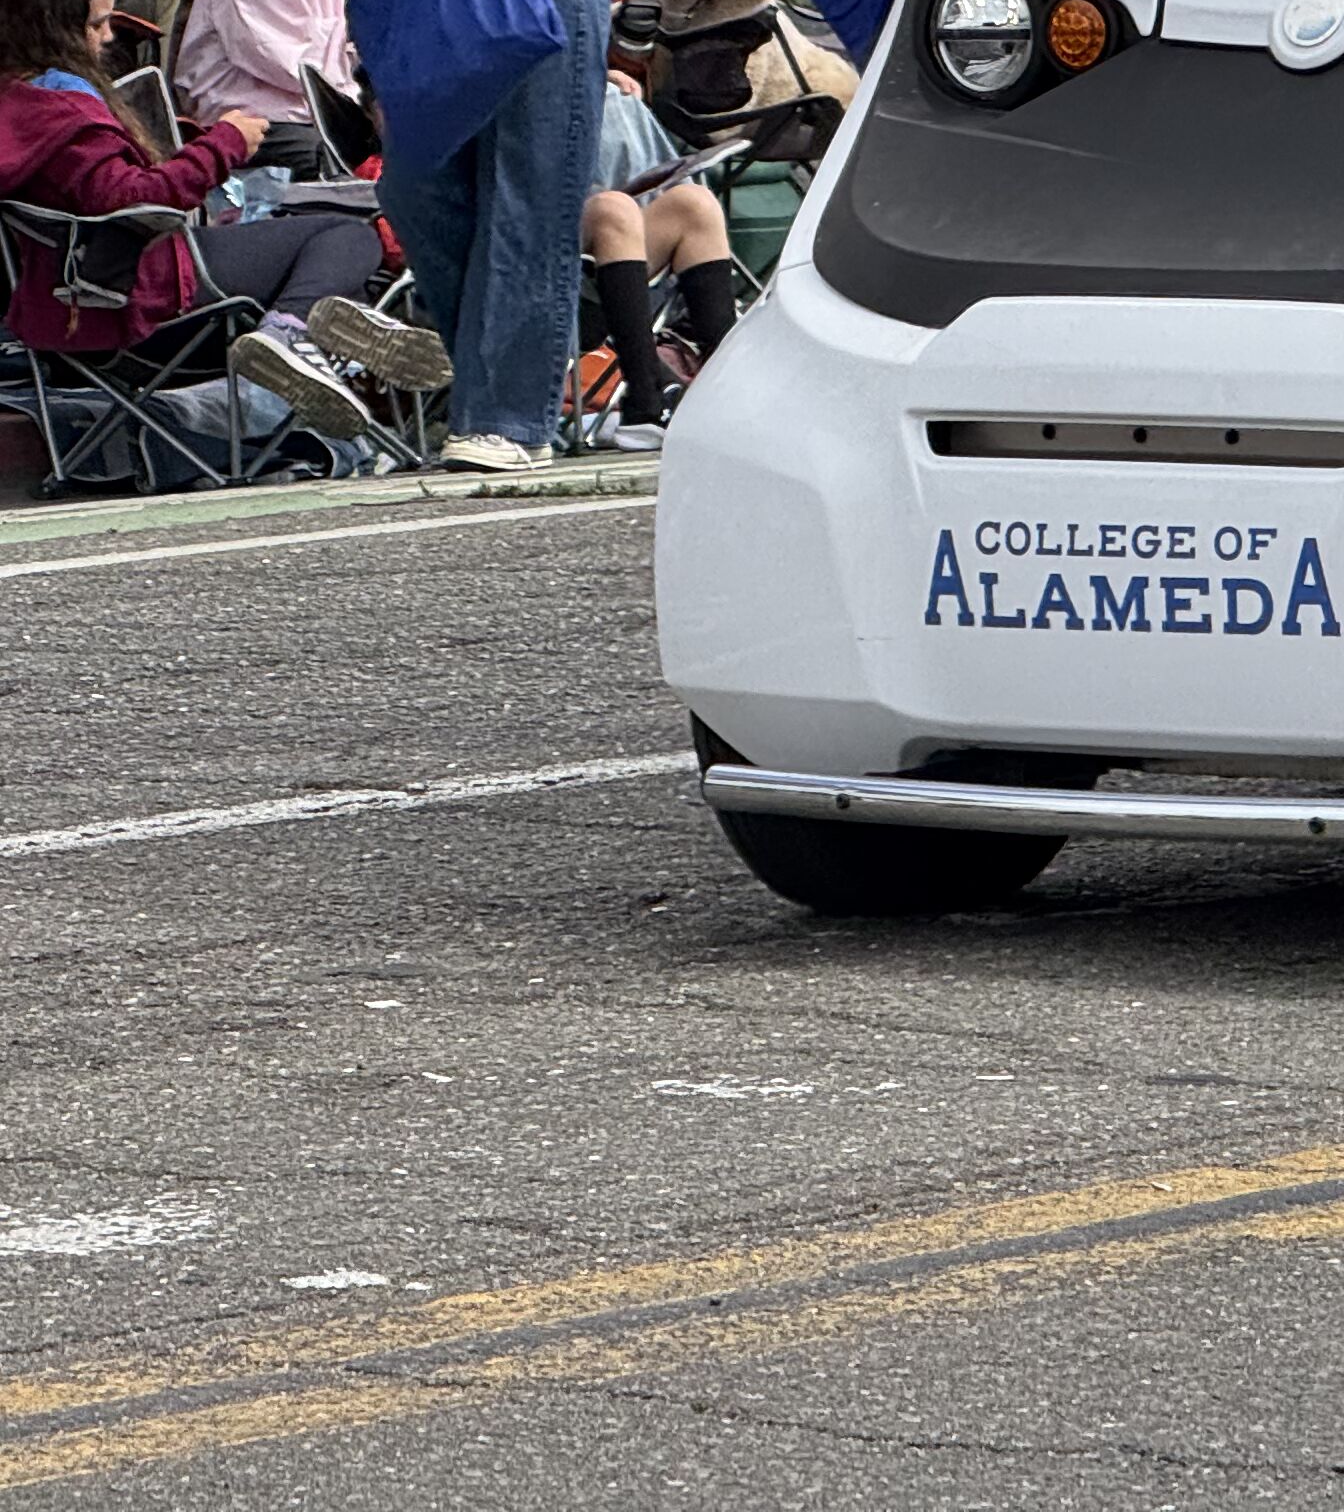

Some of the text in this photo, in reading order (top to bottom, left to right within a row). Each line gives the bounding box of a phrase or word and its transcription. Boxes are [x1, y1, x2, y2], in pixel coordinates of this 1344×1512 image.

[974, 521, 1278, 561] COLLEGE OF
[924, 529, 1342, 638] ALAMEDA
